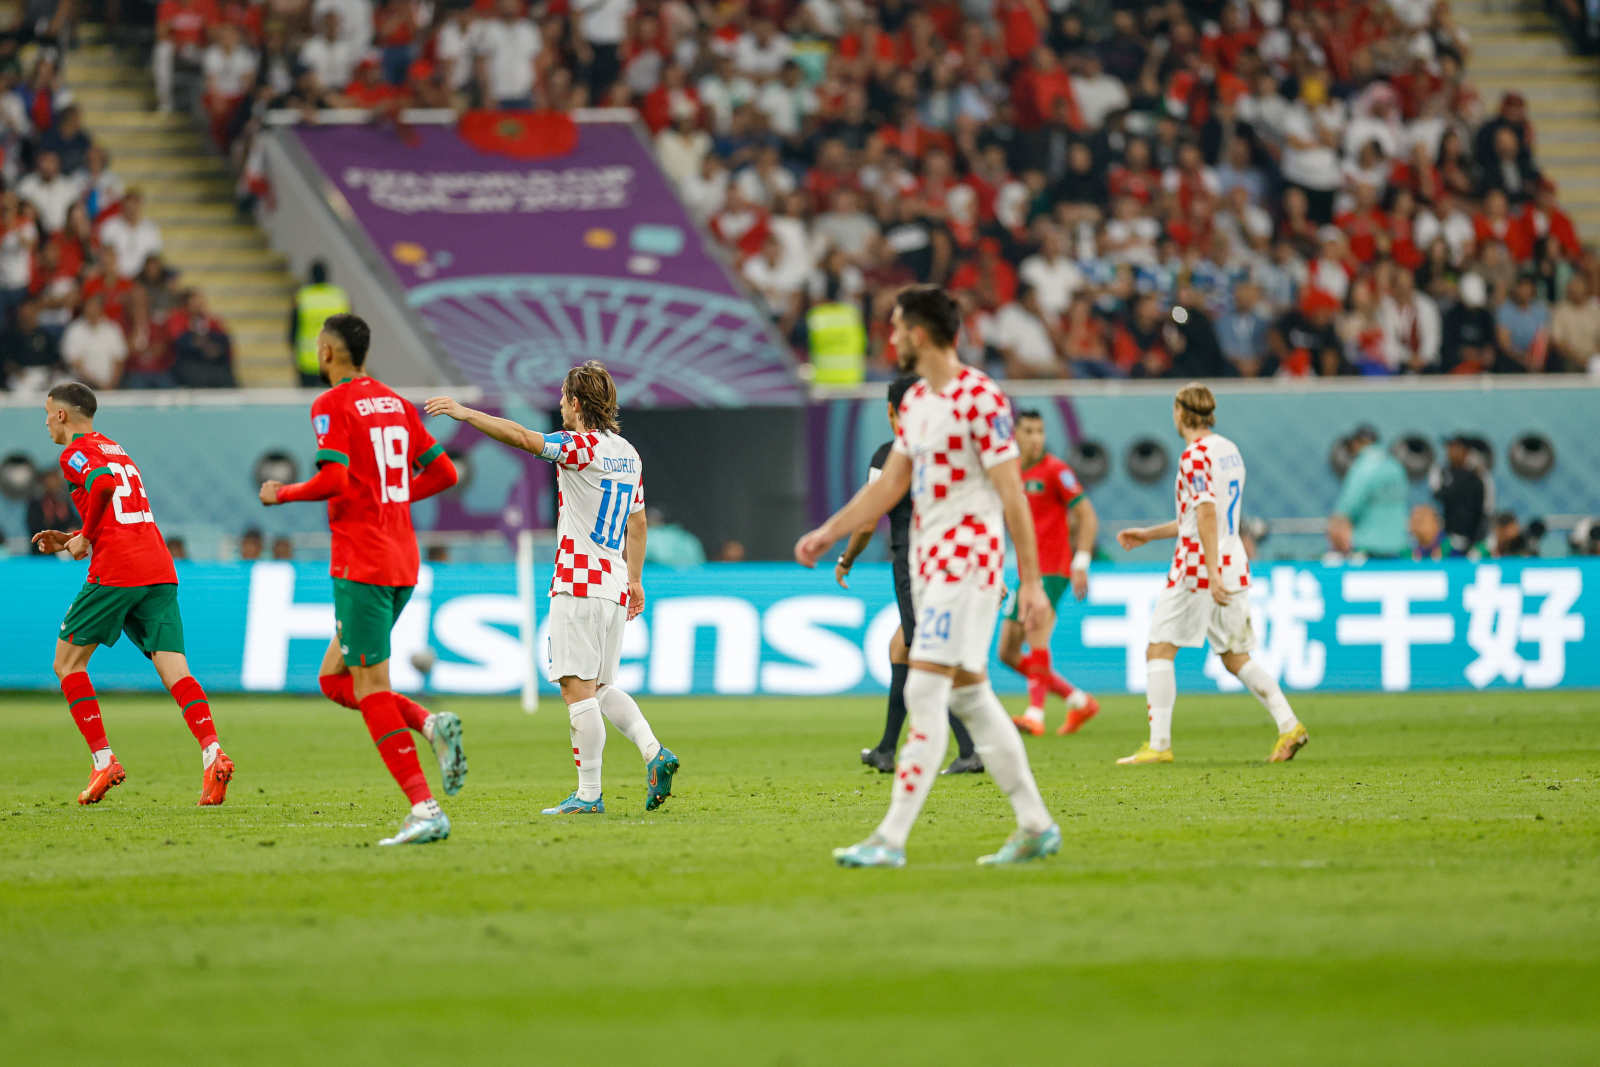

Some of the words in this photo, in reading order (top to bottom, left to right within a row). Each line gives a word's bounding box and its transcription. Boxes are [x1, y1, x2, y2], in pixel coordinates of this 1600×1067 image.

[107, 462, 154, 525] 23
[369, 425, 410, 504] 19
[589, 478, 634, 551] 10
[1226, 479, 1241, 536] 7
[921, 607, 952, 641] 24
